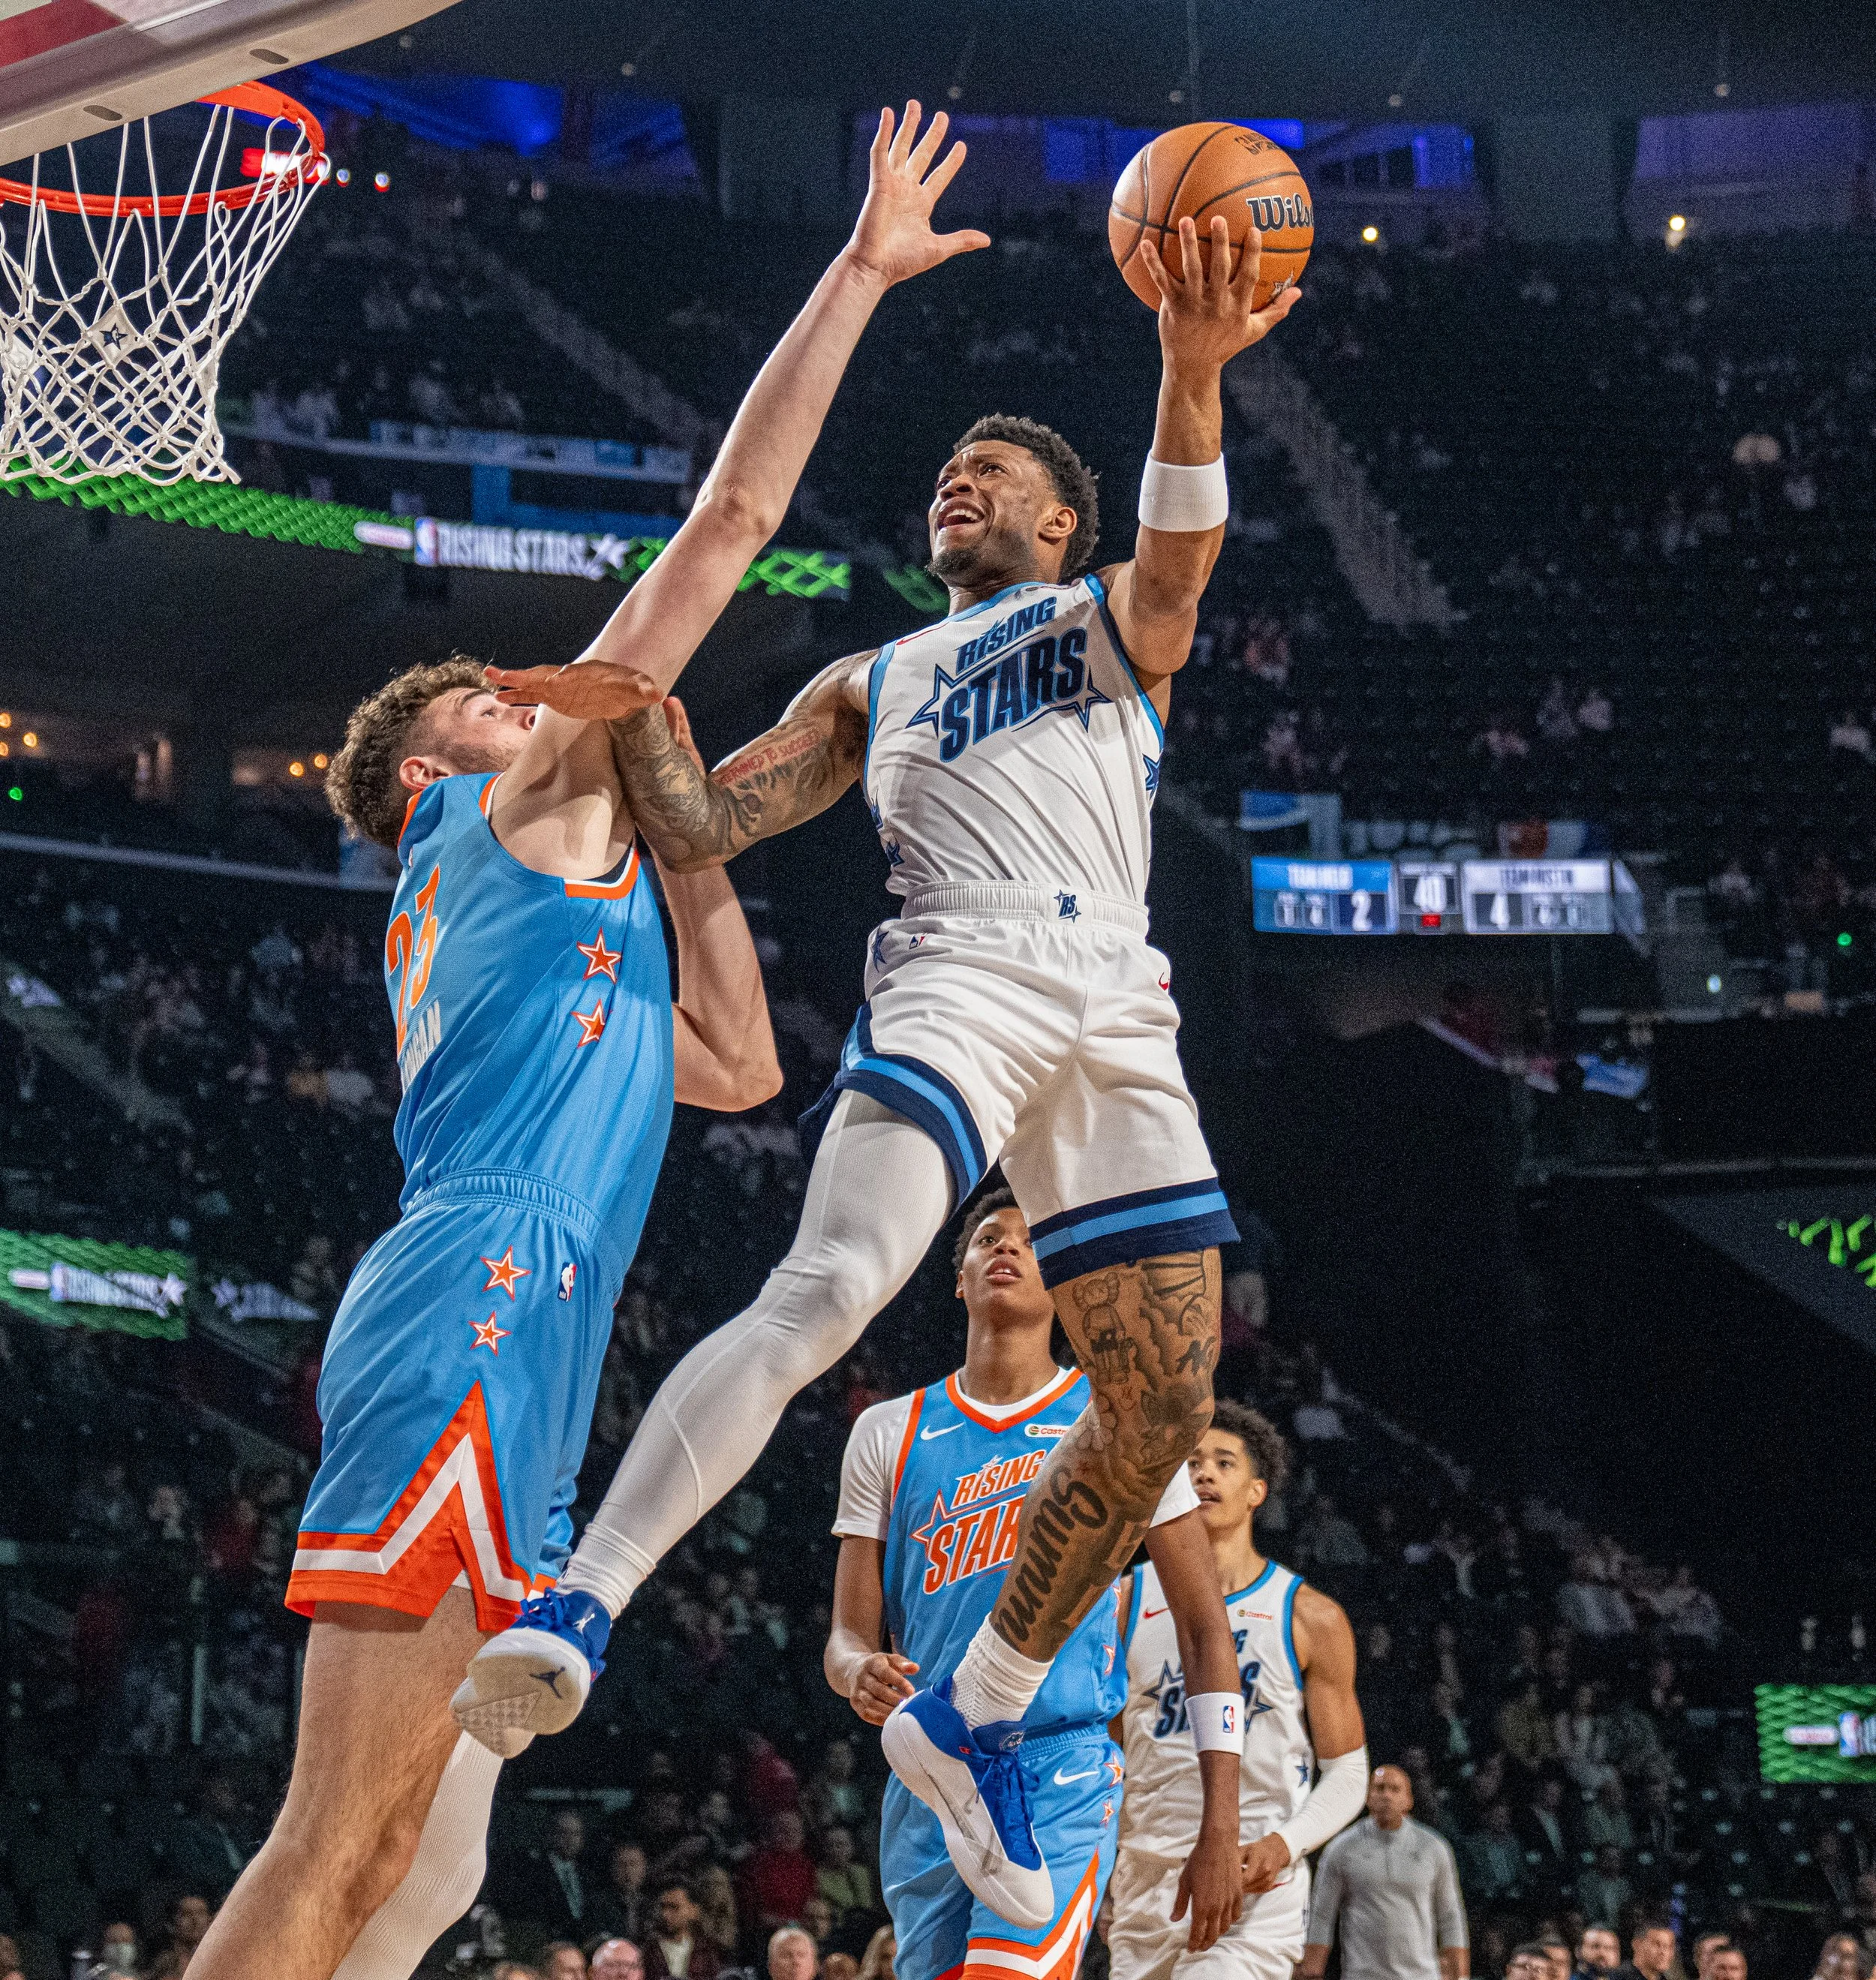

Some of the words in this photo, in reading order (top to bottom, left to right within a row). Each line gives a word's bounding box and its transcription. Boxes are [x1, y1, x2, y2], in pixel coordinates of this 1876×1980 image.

[1246, 192, 1313, 232] Wils
[437, 523, 513, 571] RISING
[514, 528, 588, 577] STARS
[953, 596, 1057, 675] RISING
[940, 626, 1087, 762] STARS
[1058, 894, 1077, 918] RS
[1351, 889, 1372, 932] 2
[385, 864, 440, 1062] 23
[950, 1450, 1047, 1510] RISING
[923, 1495, 1026, 1594] STAR
[1246, 1611, 1274, 1620] Castrol
